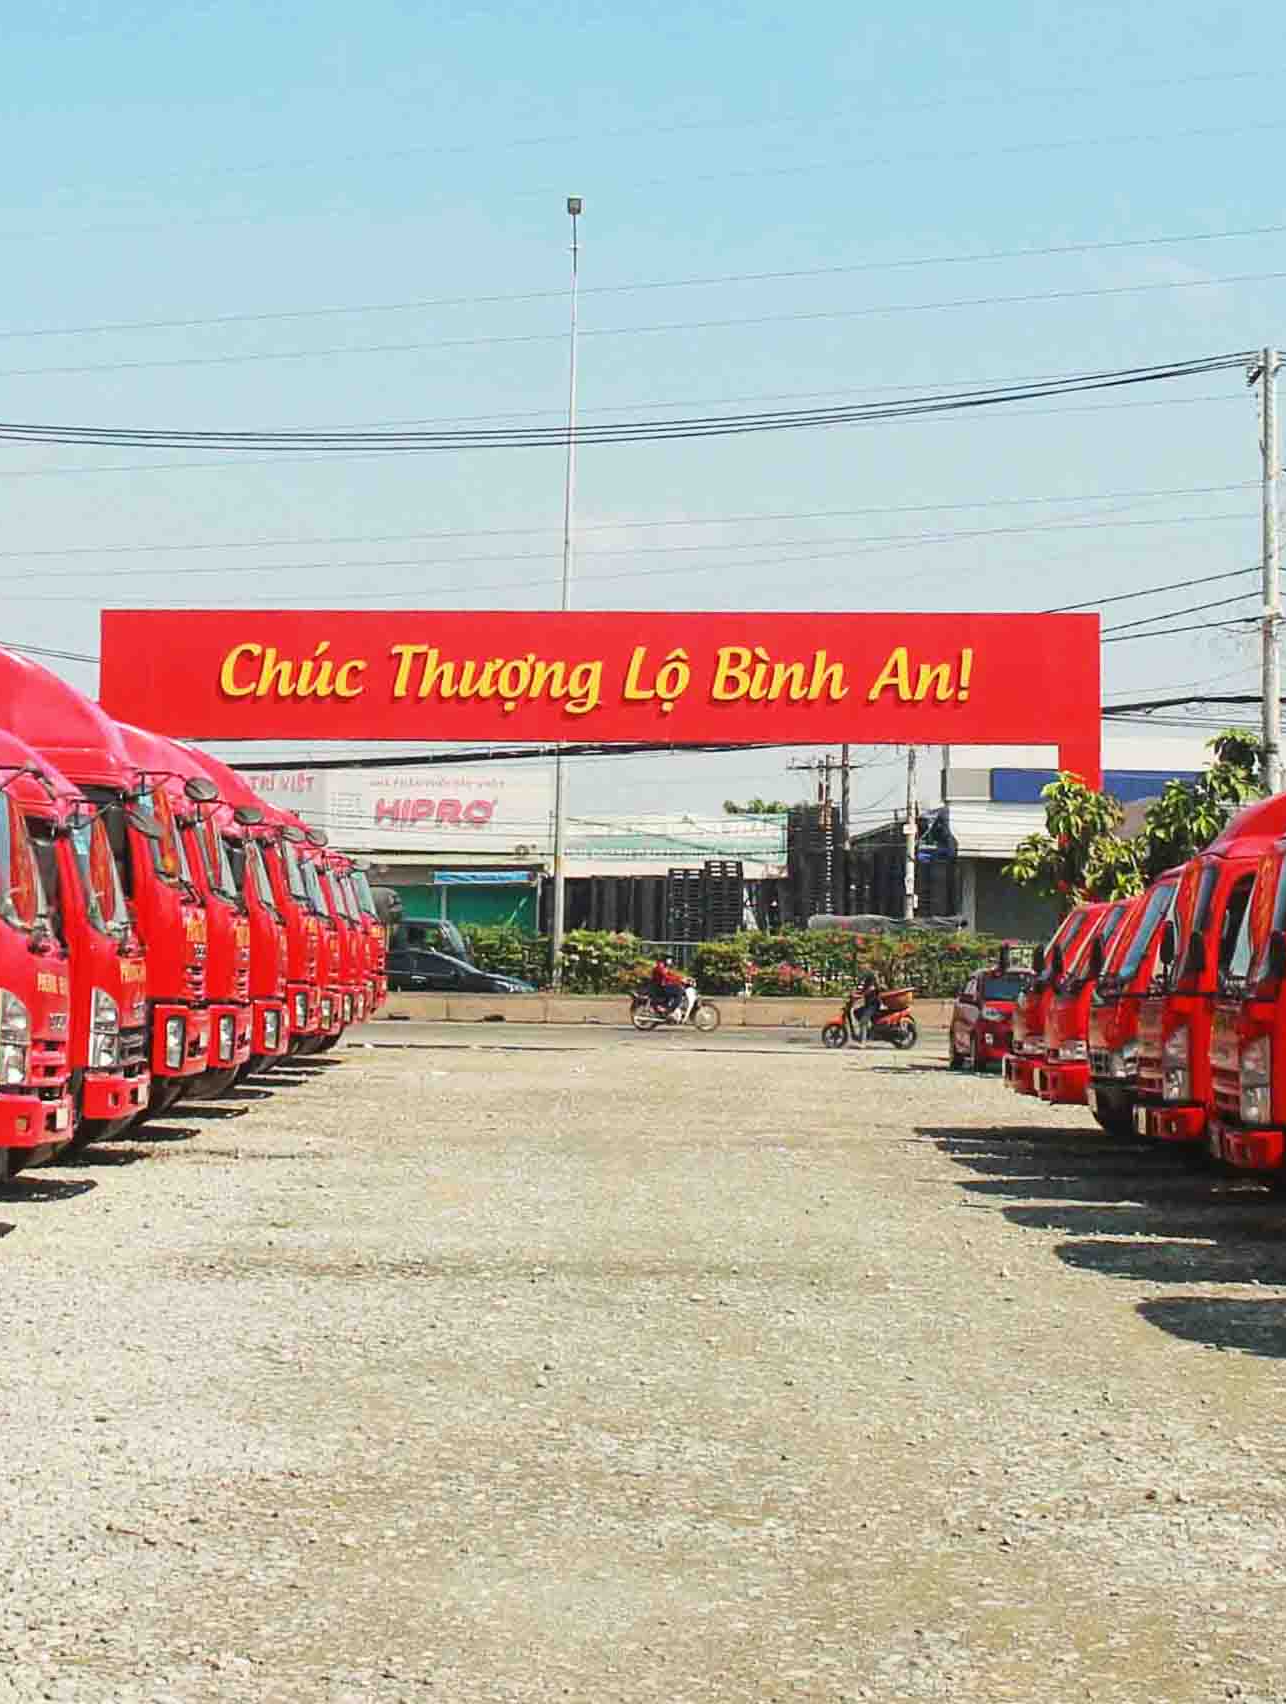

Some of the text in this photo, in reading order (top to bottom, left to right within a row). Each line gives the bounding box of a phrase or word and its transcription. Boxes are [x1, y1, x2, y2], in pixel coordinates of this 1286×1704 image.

[220, 641, 973, 713] Chúc Thượng Lộ Bình An!
